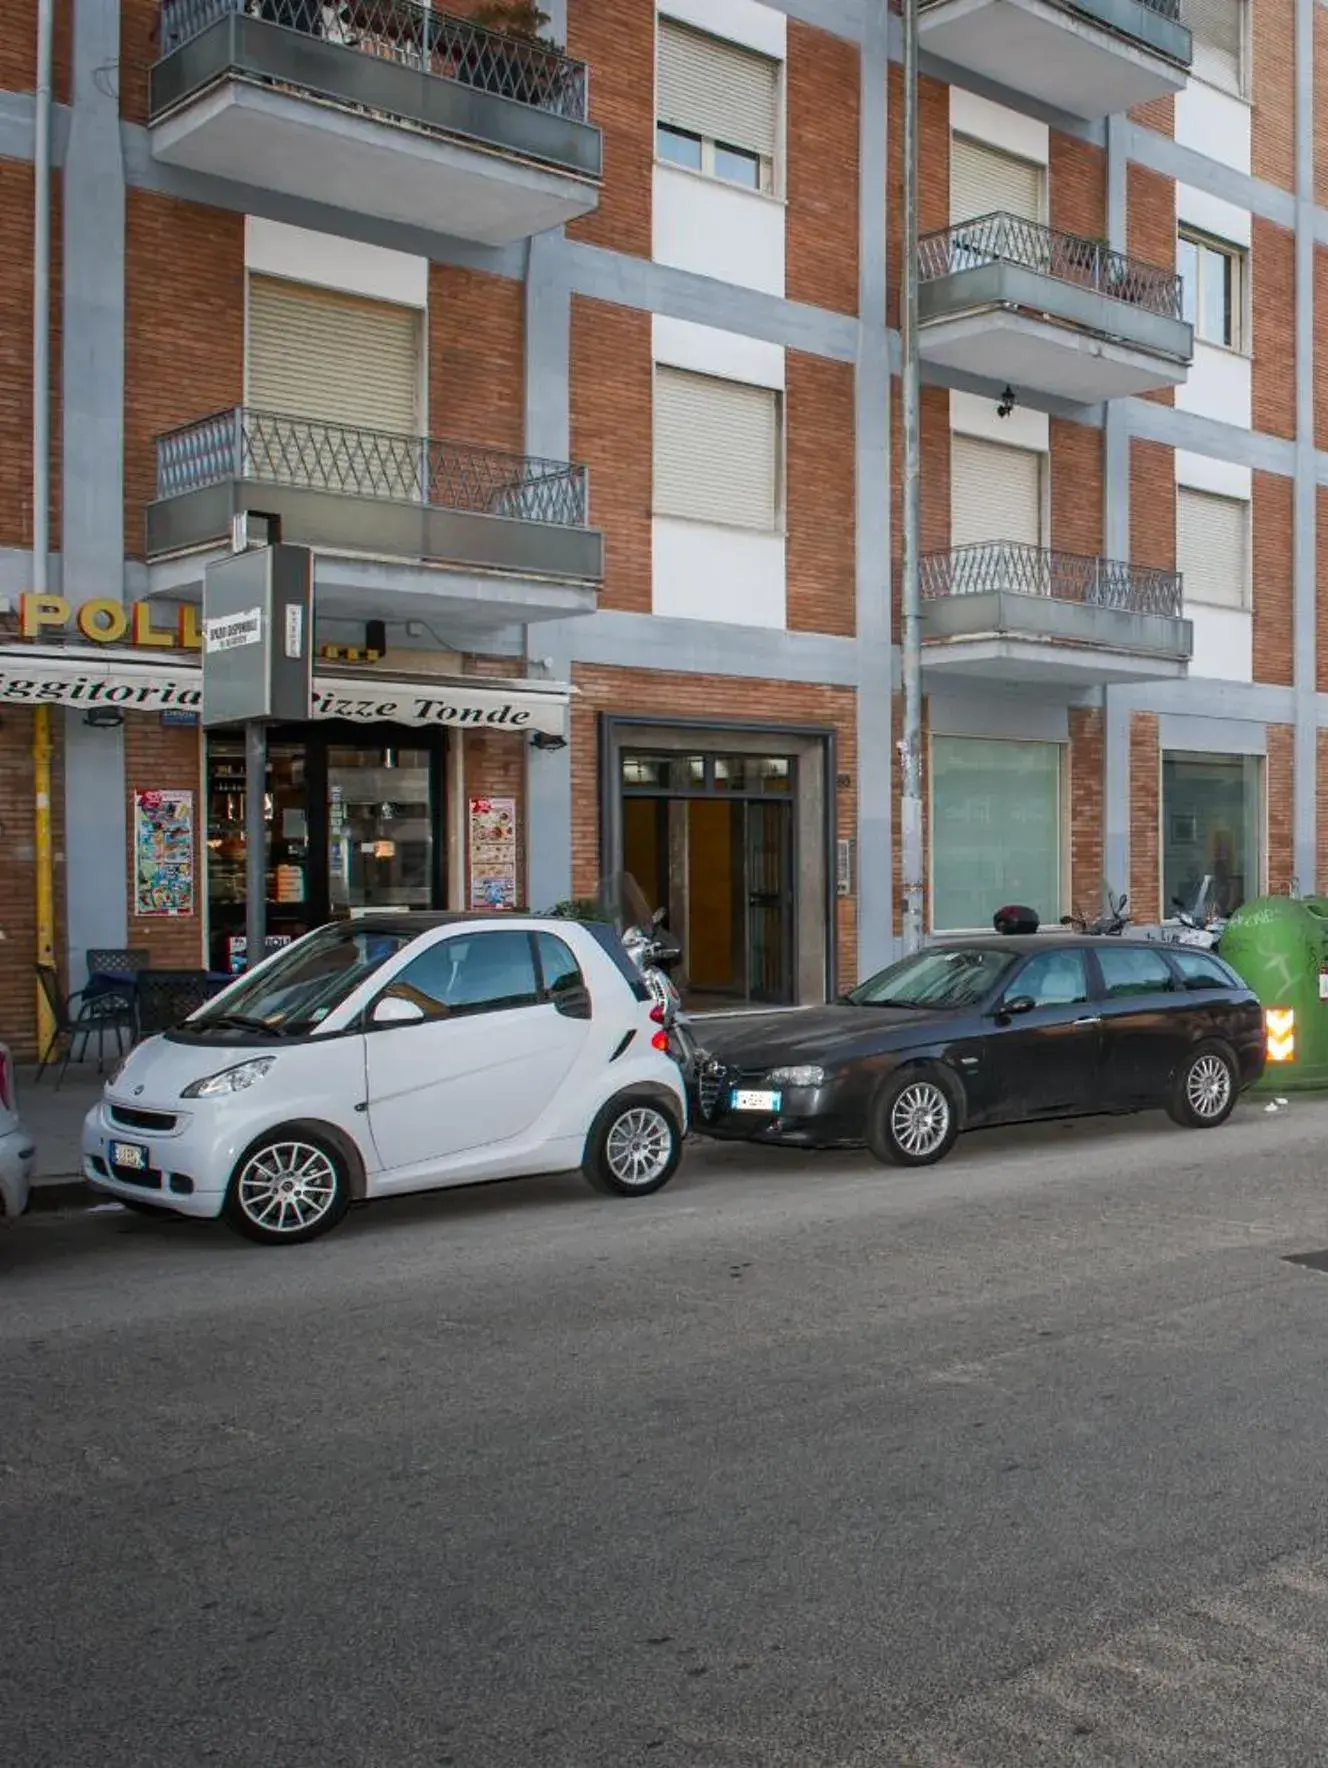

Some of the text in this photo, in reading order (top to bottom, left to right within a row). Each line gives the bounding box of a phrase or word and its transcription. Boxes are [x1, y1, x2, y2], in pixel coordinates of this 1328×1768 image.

[0, 673, 531, 726] ggitoria izze Tonde
